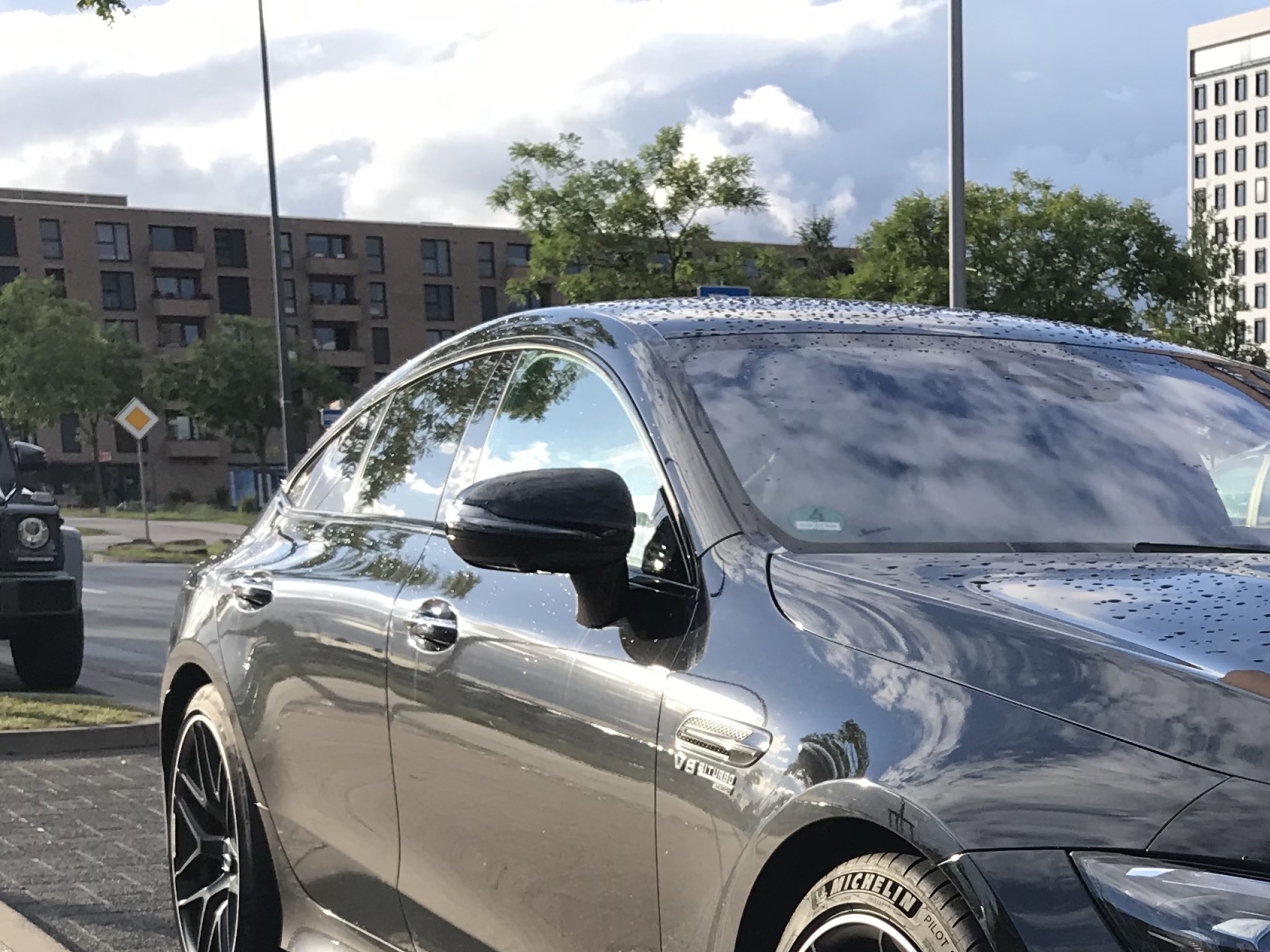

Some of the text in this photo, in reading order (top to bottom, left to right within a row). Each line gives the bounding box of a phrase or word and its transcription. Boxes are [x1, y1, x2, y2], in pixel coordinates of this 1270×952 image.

[674, 751, 736, 785] V8 BITURBO
[829, 872, 916, 913] MICHELIN
[924, 914, 949, 947] PILOT
